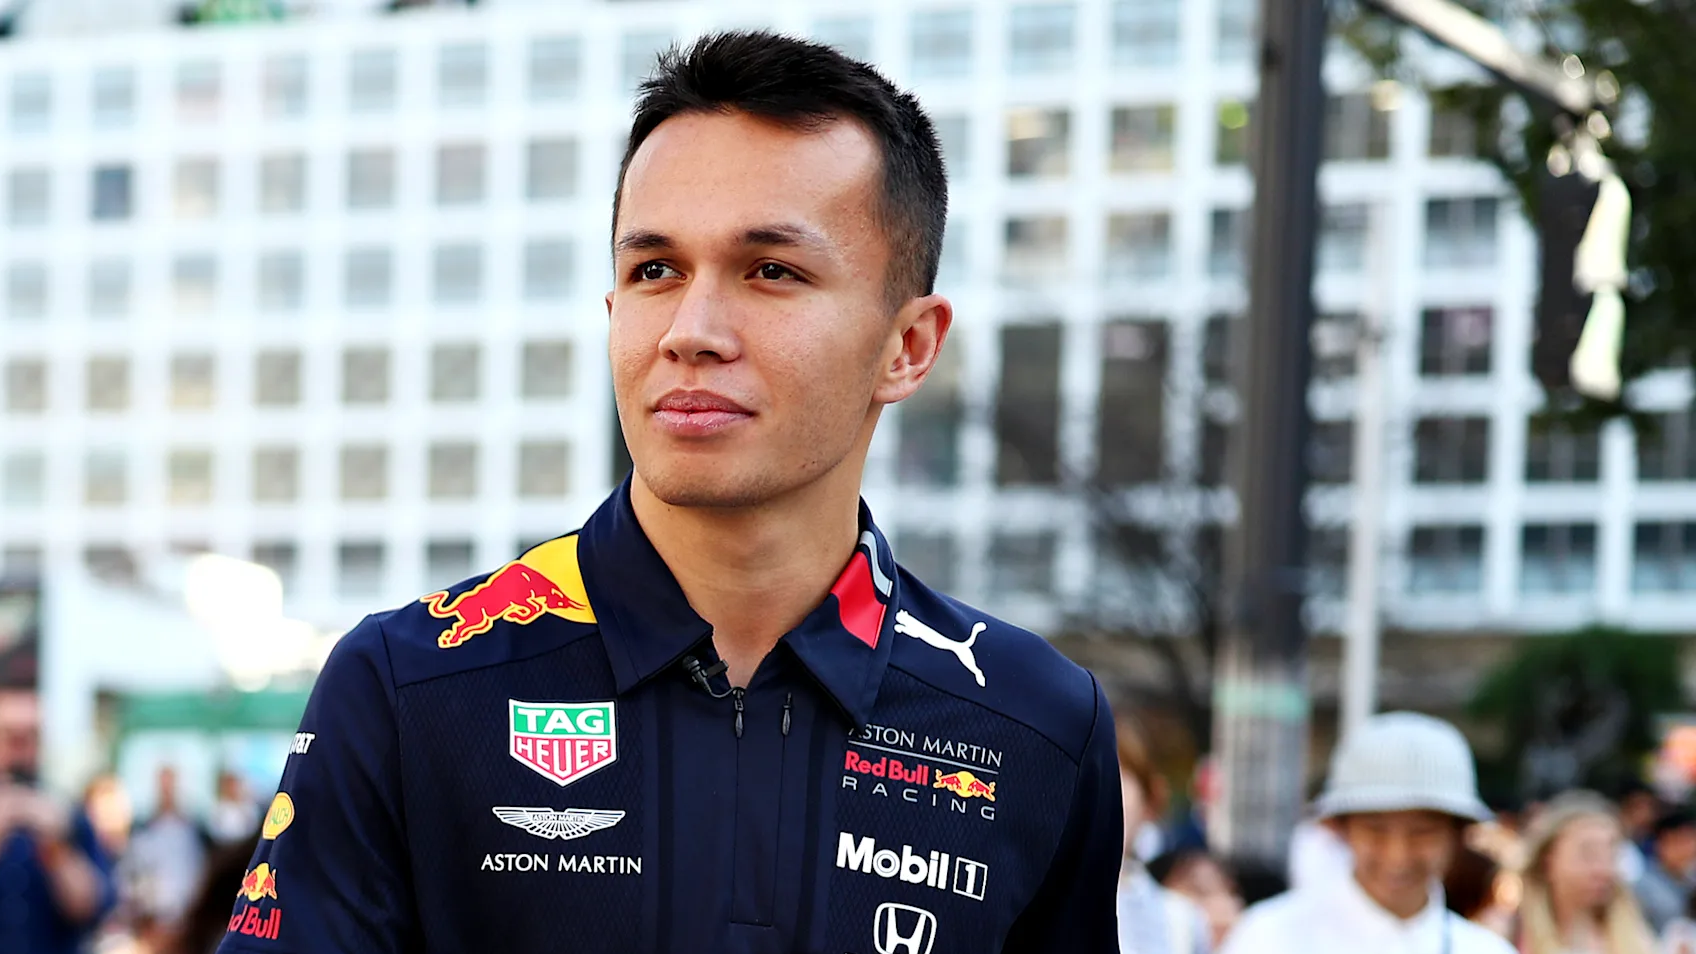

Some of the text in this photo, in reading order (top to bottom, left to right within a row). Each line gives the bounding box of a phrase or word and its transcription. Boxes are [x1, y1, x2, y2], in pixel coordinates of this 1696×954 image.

[517, 707, 604, 733] TAG
[516, 738, 608, 777] HEUER
[848, 723, 1002, 767] STON MARTIN
[842, 775, 995, 821] RACING
[481, 854, 642, 874] ASTON MARTIN
[836, 832, 949, 890] Mobil
